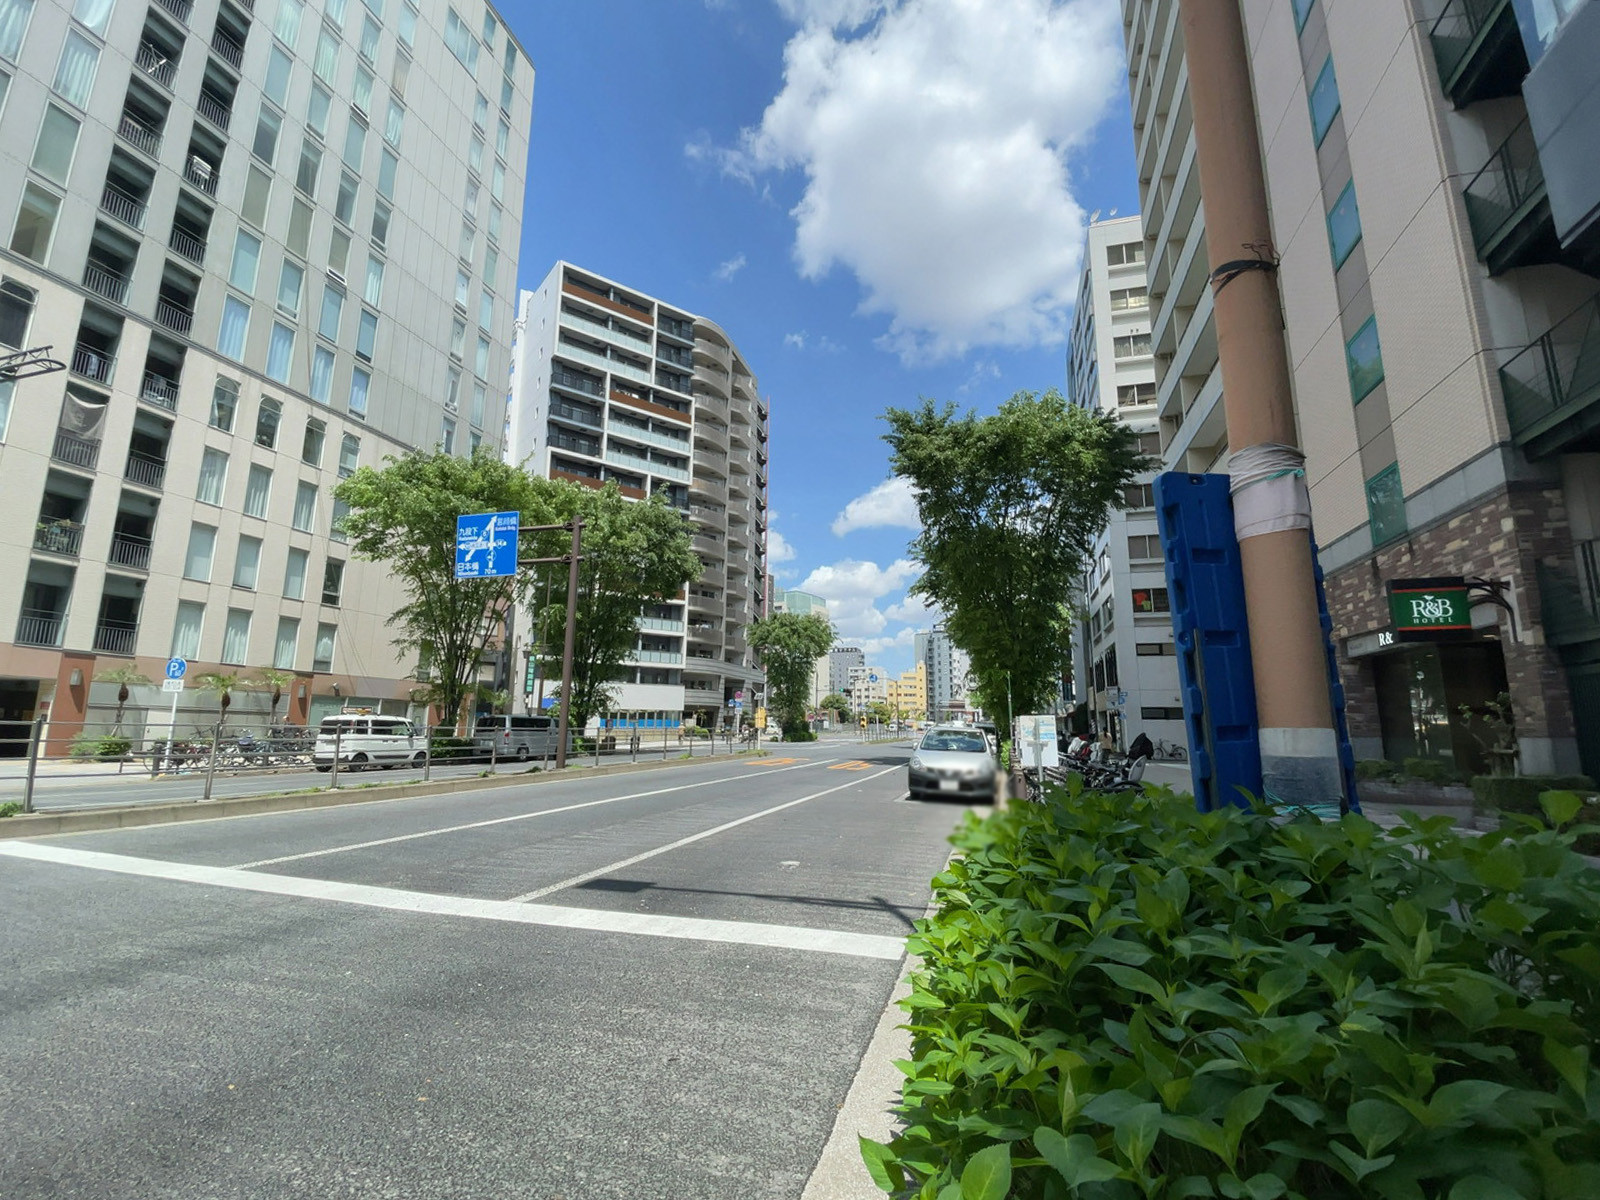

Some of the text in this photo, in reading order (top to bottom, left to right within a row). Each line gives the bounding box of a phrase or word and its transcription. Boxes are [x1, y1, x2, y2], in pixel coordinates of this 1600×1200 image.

[458, 526, 478, 537] 九段下
[457, 561, 479, 572] 日本橋
[1410, 598, 1453, 618] R&B
[1378, 631, 1394, 646] R&
[169, 662, 179, 676] P
